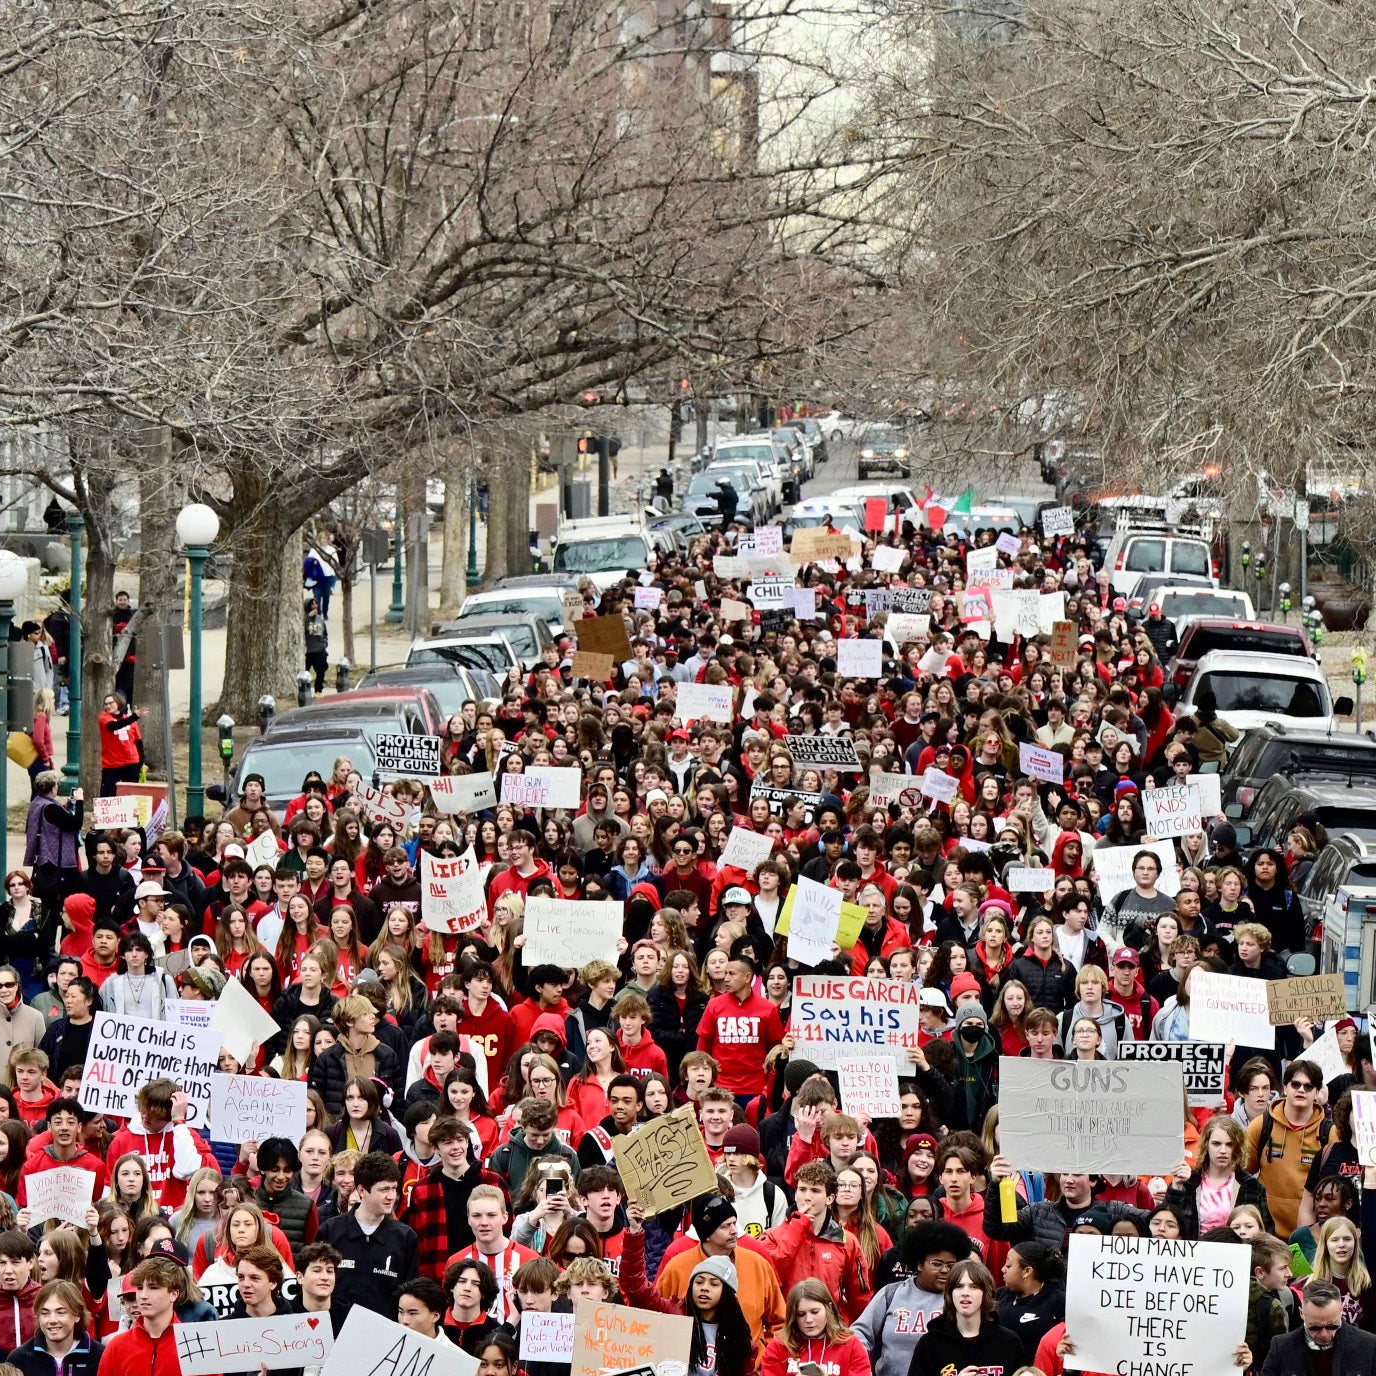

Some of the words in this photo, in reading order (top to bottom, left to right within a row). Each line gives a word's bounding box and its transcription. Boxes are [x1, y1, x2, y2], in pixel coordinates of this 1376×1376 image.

[378, 734, 437, 749] PROTECT
[787, 736, 851, 747] PROTECT
[789, 744, 855, 755] CHILDREN
[378, 746, 438, 760] CHILDREN
[793, 751, 817, 762] NOT
[820, 753, 857, 764] GUNS
[378, 758, 402, 769] NOT
[405, 760, 438, 771] GUNS
[504, 776, 521, 786] END
[1145, 786, 1192, 800] PROTECT
[1156, 798, 1186, 814] KIDS
[1149, 820, 1171, 836] NOT
[1175, 815, 1201, 831] GUNS
[801, 1002, 849, 1026] Say
[717, 1017, 760, 1036] EAST
[792, 1024, 823, 1041] #11
[825, 1028, 885, 1044] NAME
[887, 1032, 916, 1048] #11
[1121, 1044, 1221, 1059] PROTECT
[145, 1053, 182, 1073] more
[86, 1062, 116, 1084] ALL
[1050, 1065, 1130, 1093] GUNS
[228, 1078, 296, 1100] ANGELS
[843, 1076, 892, 1088] LISTEN
[845, 1090, 870, 1099] WHEN
[225, 1098, 296, 1118] AGAINST
[868, 1103, 900, 1114] CHILD
[1101, 1236, 1139, 1254] HOW
[1148, 1239, 1198, 1258] MANY
[1092, 1261, 1144, 1282] KIDS
[1155, 1265, 1204, 1286] HAVE
[1213, 1269, 1234, 1288] TO
[1101, 1290, 1135, 1308] DIE
[1146, 1292, 1219, 1315] BEFORE
[1127, 1316, 1187, 1339] THERE
[1143, 1341, 1166, 1357] IS
